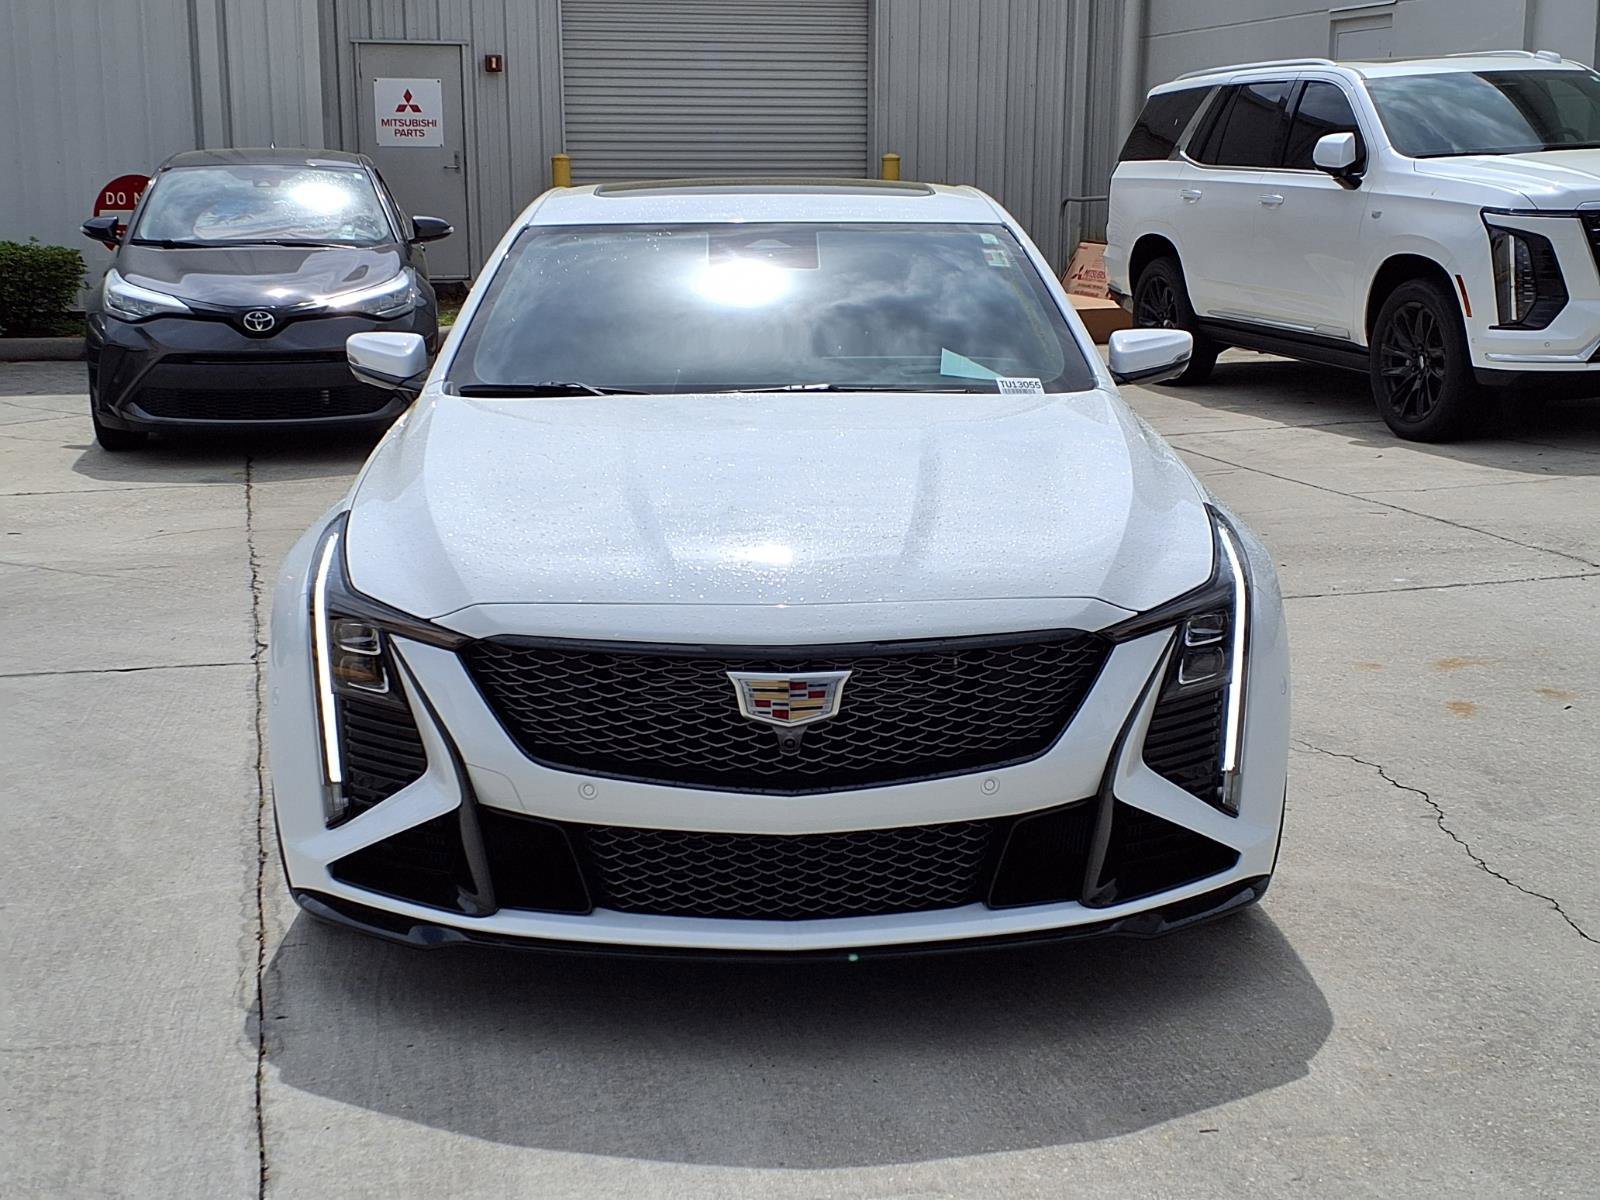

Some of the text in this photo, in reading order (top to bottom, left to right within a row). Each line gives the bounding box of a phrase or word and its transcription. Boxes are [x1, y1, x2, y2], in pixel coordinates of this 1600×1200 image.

[381, 119, 437, 128] MITSUBISHI
[394, 129, 425, 138] PARTS
[105, 191, 127, 205] DO
[1000, 380, 1041, 389] TU13055
